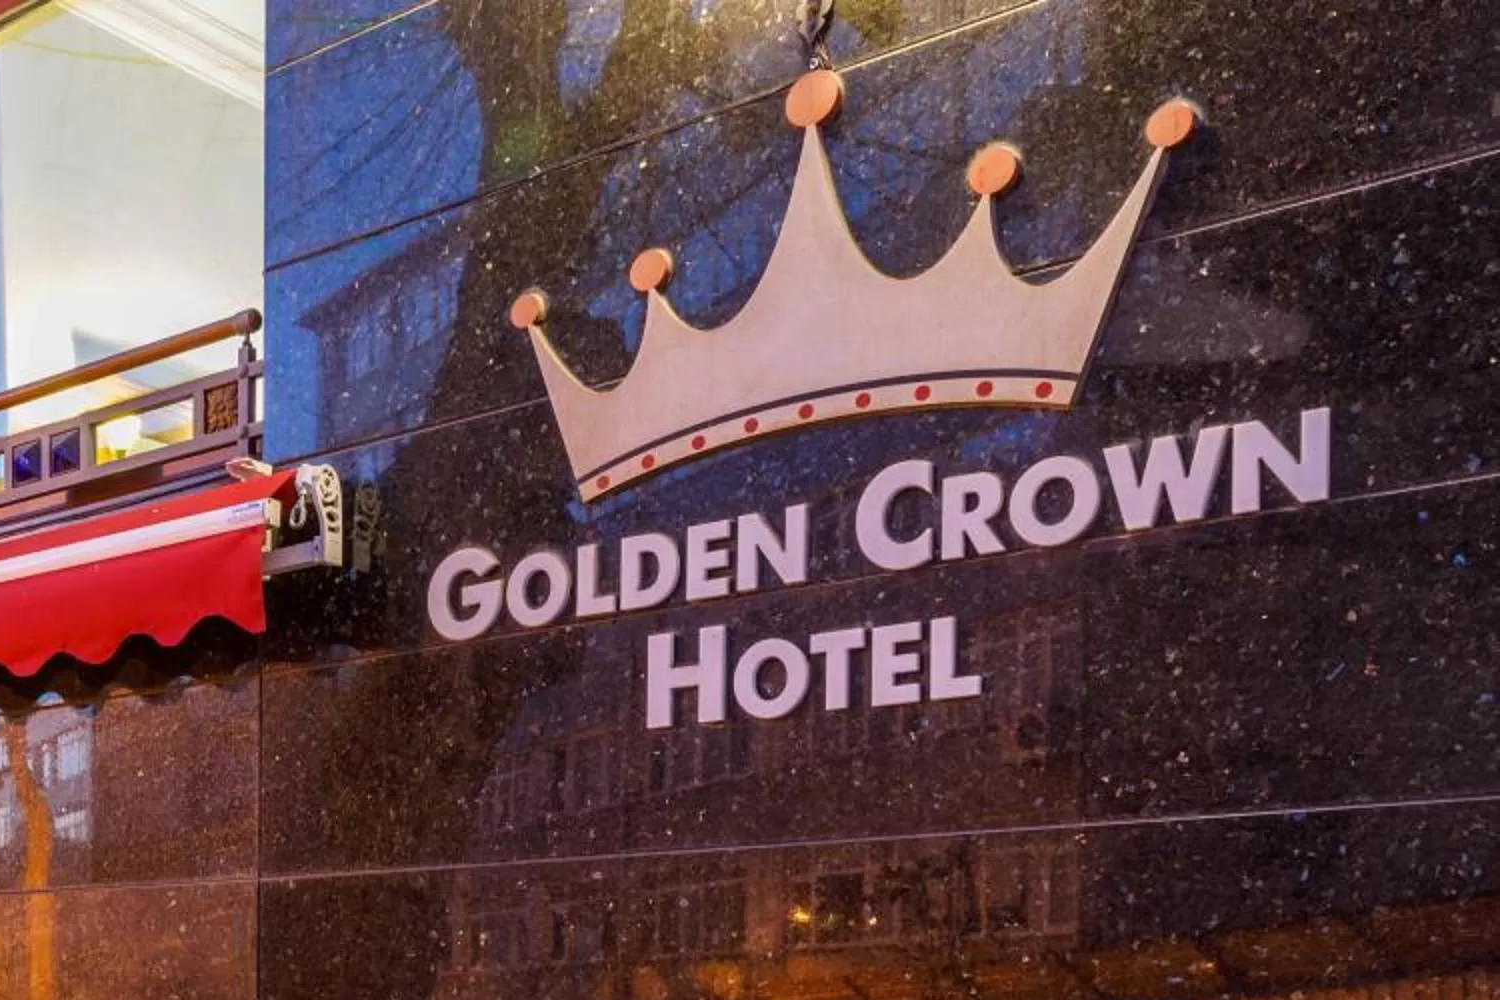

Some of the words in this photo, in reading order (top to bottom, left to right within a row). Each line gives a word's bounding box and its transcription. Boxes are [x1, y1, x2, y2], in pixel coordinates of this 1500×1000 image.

[427, 503, 808, 642] GOLDEN
[855, 406, 1331, 571] CROWN
[645, 615, 983, 731] HOTEL
